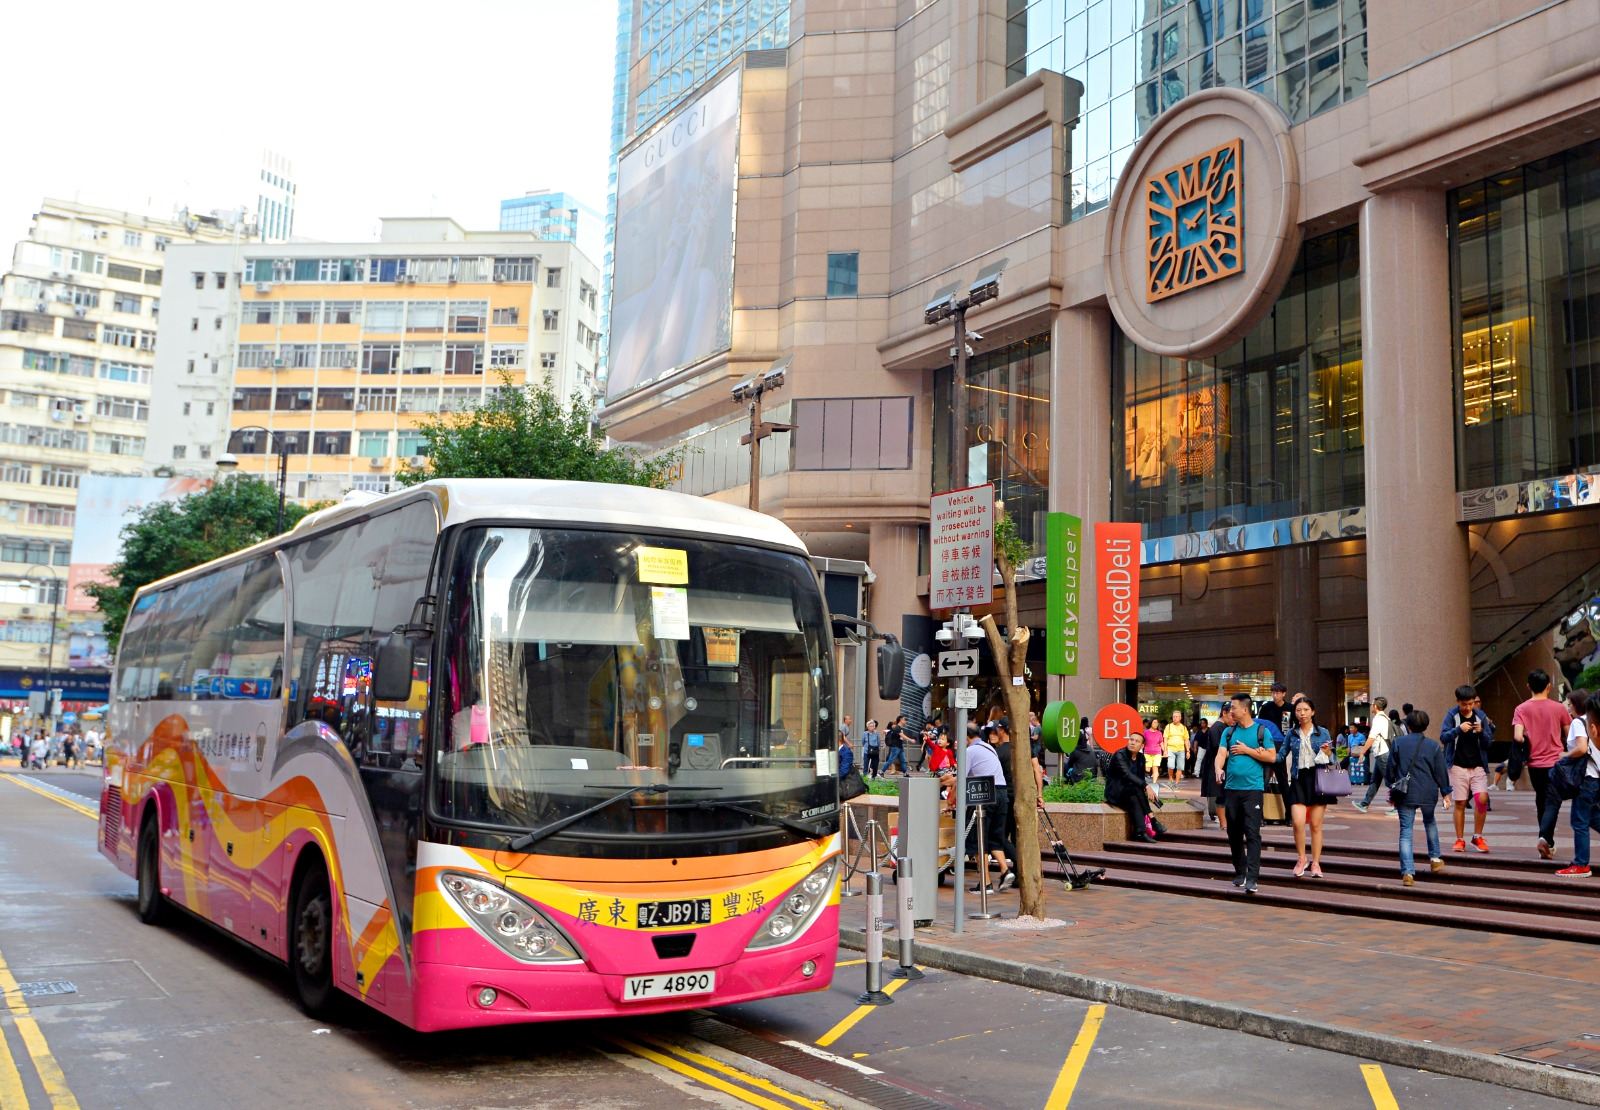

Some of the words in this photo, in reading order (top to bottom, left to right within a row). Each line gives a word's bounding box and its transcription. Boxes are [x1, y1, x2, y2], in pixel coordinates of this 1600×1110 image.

[644, 105, 706, 168] GUCCI
[947, 495, 974, 506] Vehicle
[936, 509, 962, 521] waiting
[963, 505, 976, 516] will
[977, 504, 987, 514] be
[941, 517, 981, 533] prosecuted
[933, 533, 959, 545] without
[961, 529, 990, 541] warning
[941, 544, 981, 563] 停車等候
[941, 565, 981, 583] 會被檢控
[936, 585, 985, 603] 而不予警告
[1105, 539, 1131, 667] cookedDeli
[1062, 717, 1076, 738] B1
[1104, 719, 1131, 739] B1
[575, 898, 629, 927] 廣東
[721, 890, 766, 919] 豐源
[631, 979, 655, 996] VF
[663, 974, 709, 993] 4890
